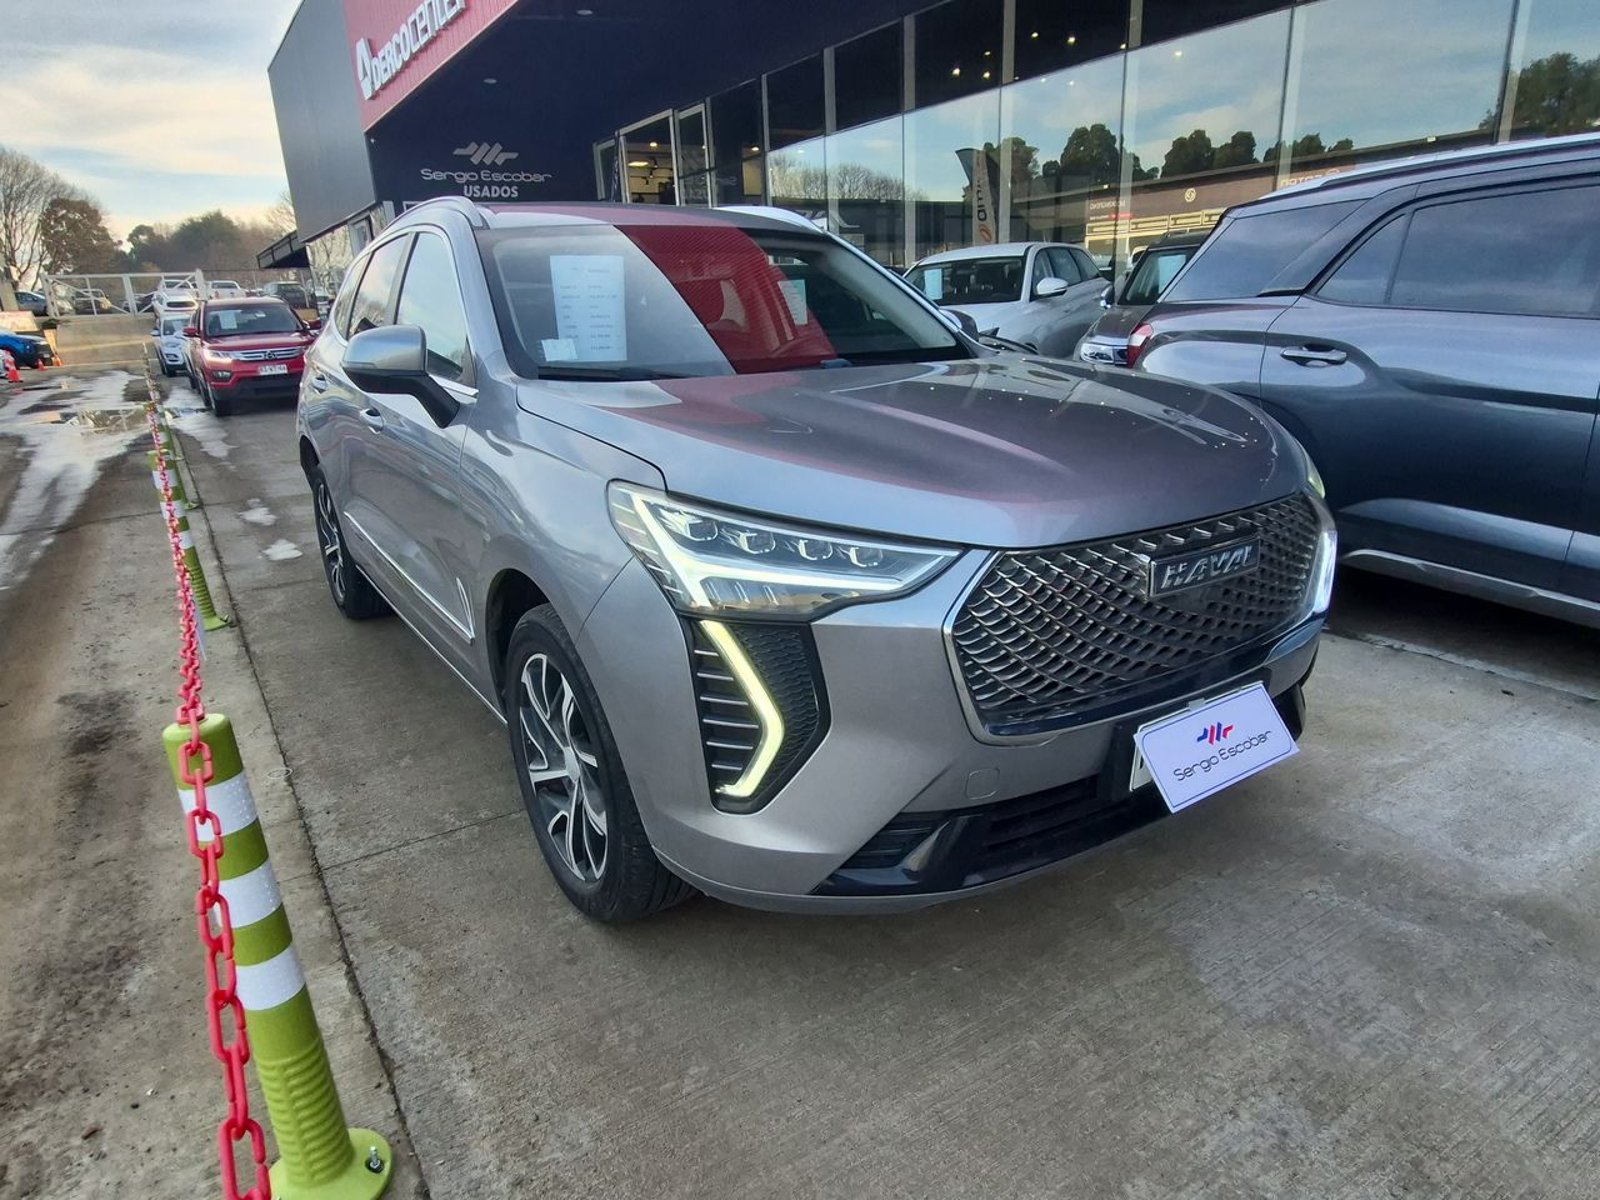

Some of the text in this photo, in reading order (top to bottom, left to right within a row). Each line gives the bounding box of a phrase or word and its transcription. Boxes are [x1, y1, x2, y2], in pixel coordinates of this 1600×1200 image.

[420, 168, 552, 184] Sergo Escobar
[463, 185, 518, 198] USADOS
[1161, 546, 1253, 589] HAVAL
[1173, 730, 1272, 782] Sergo Escobar
